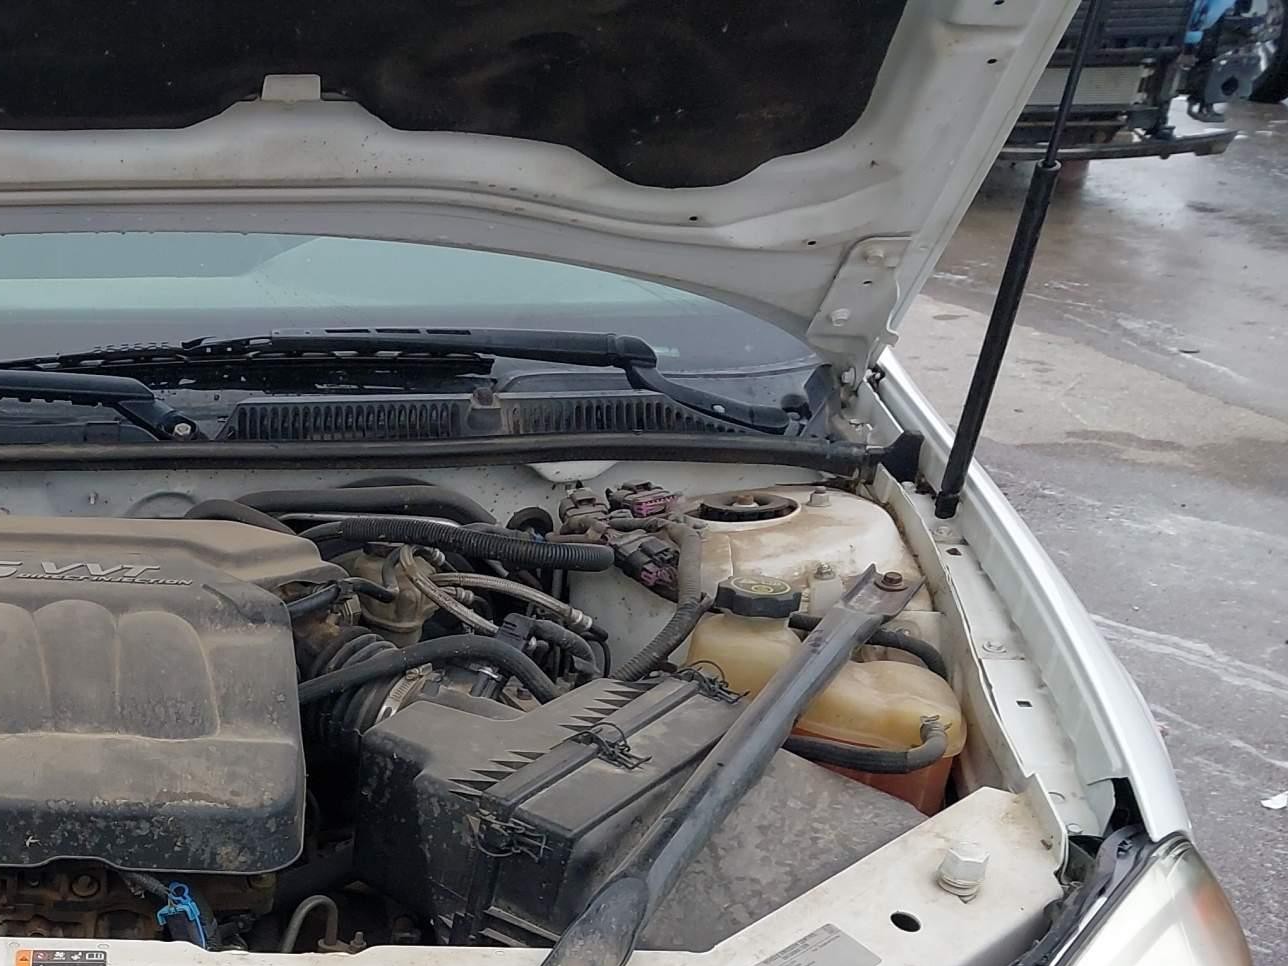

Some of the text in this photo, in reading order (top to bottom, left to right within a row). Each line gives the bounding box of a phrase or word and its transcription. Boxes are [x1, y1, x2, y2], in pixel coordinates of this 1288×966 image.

[41, 561, 160, 578] VVT
[15, 573, 193, 586] DIRECT INJECTION
